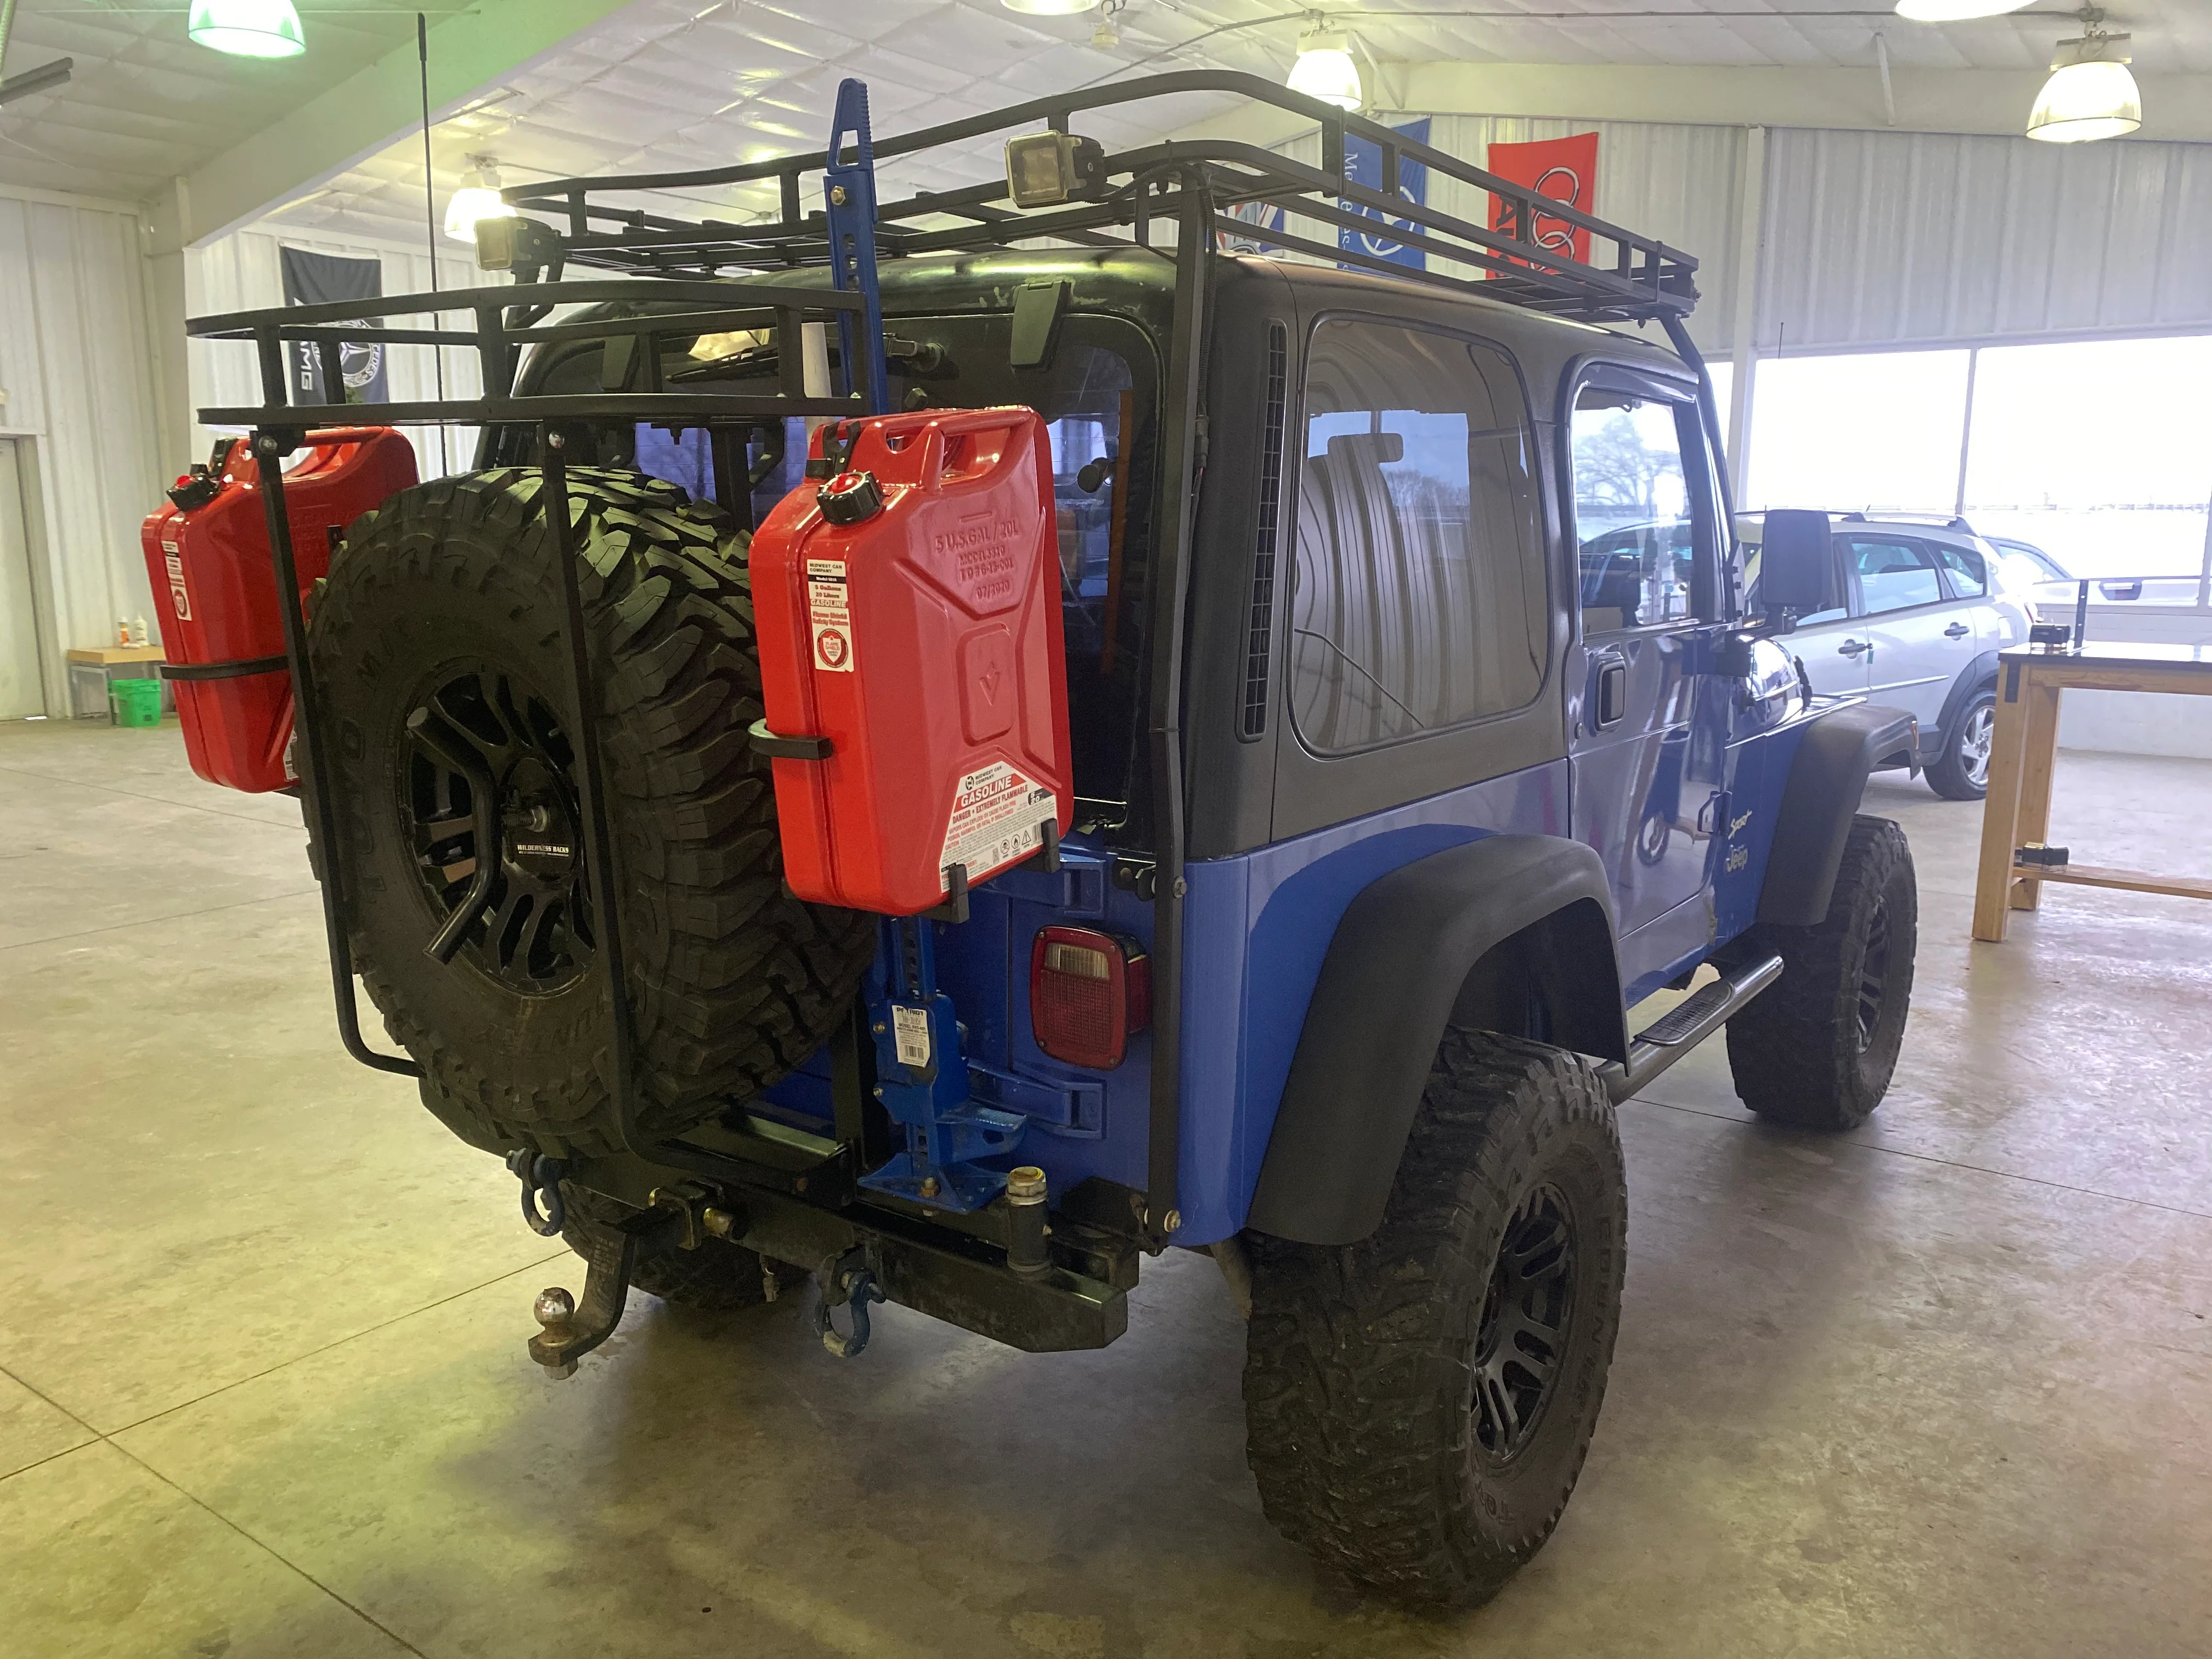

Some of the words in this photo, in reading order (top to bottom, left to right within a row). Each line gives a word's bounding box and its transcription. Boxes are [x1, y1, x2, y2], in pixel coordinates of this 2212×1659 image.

[810, 599, 847, 608] GASOLINE
[975, 769, 994, 780] MIDWEST
[975, 774, 995, 785] COMPANY
[961, 775, 1012, 808] GASOLINE
[952, 810, 971, 824] DANGER
[976, 796, 1001, 814] EXTREMELY
[1002, 785, 1028, 802] FLAMMABLE
[1030, 795, 1040, 805] 20
[949, 825, 962, 834] VAPORS
[989, 807, 998, 816] CAUSE
[999, 804, 1009, 813] FLASH
